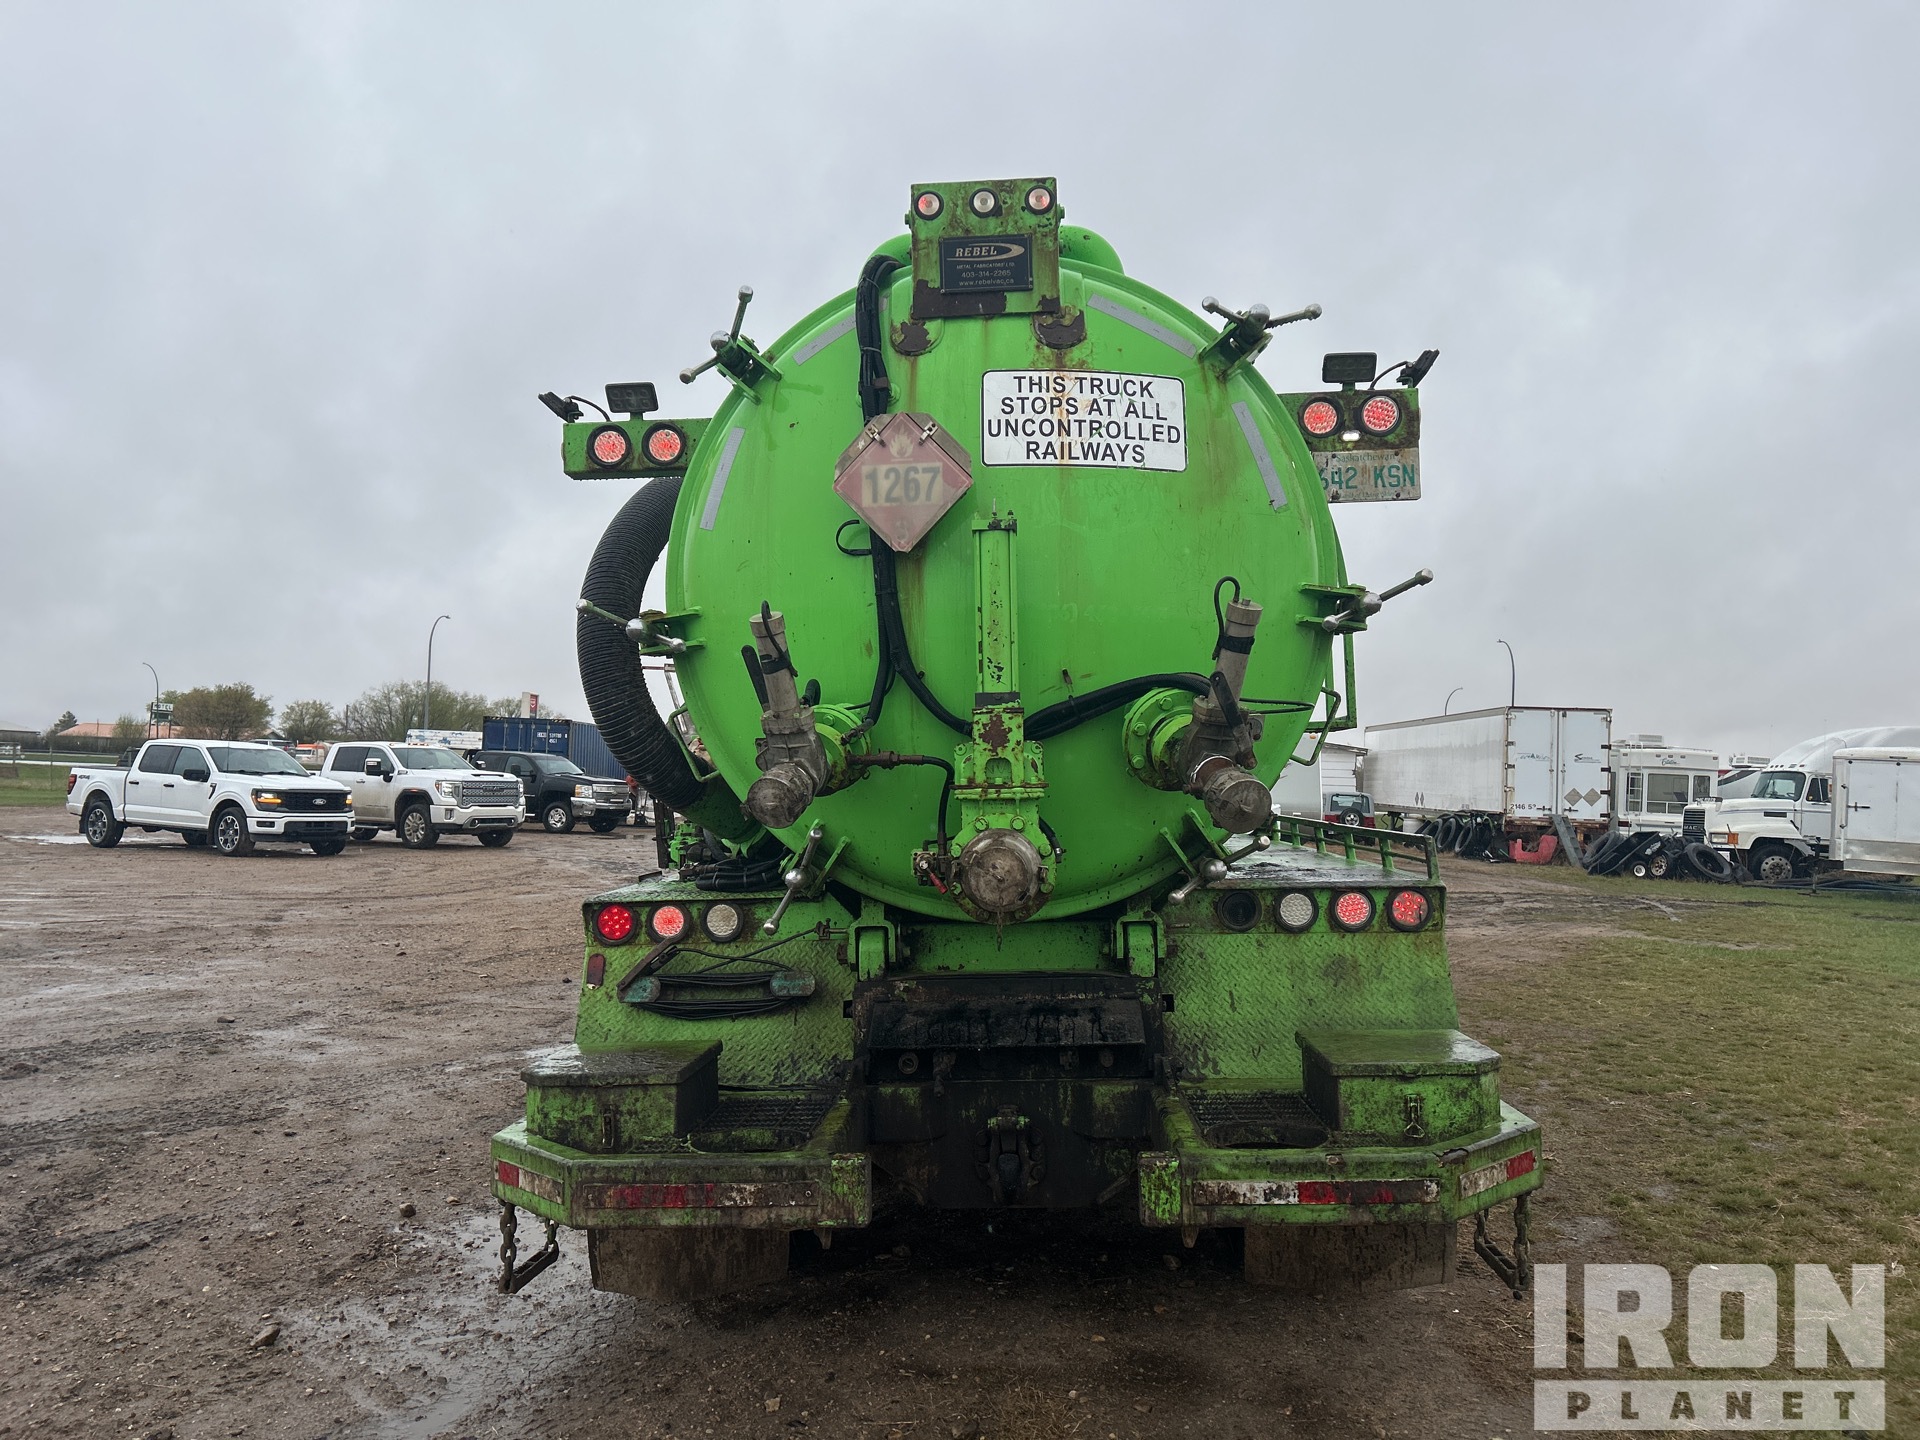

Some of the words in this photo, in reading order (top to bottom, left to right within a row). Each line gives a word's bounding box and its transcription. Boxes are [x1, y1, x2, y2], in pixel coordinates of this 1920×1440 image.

[955, 246, 997, 257] REBEL
[1013, 375, 1067, 394] THIS
[1074, 376, 1154, 399] TRUCK
[1001, 396, 1079, 415] STOPS
[1087, 398, 1116, 416] AT
[1124, 399, 1168, 421] ALL
[987, 418, 1181, 444] UNCONTROLLED
[1025, 440, 1145, 464] RAILWAYS
[864, 465, 941, 504] 1267
[1373, 464, 1416, 488] KSN
